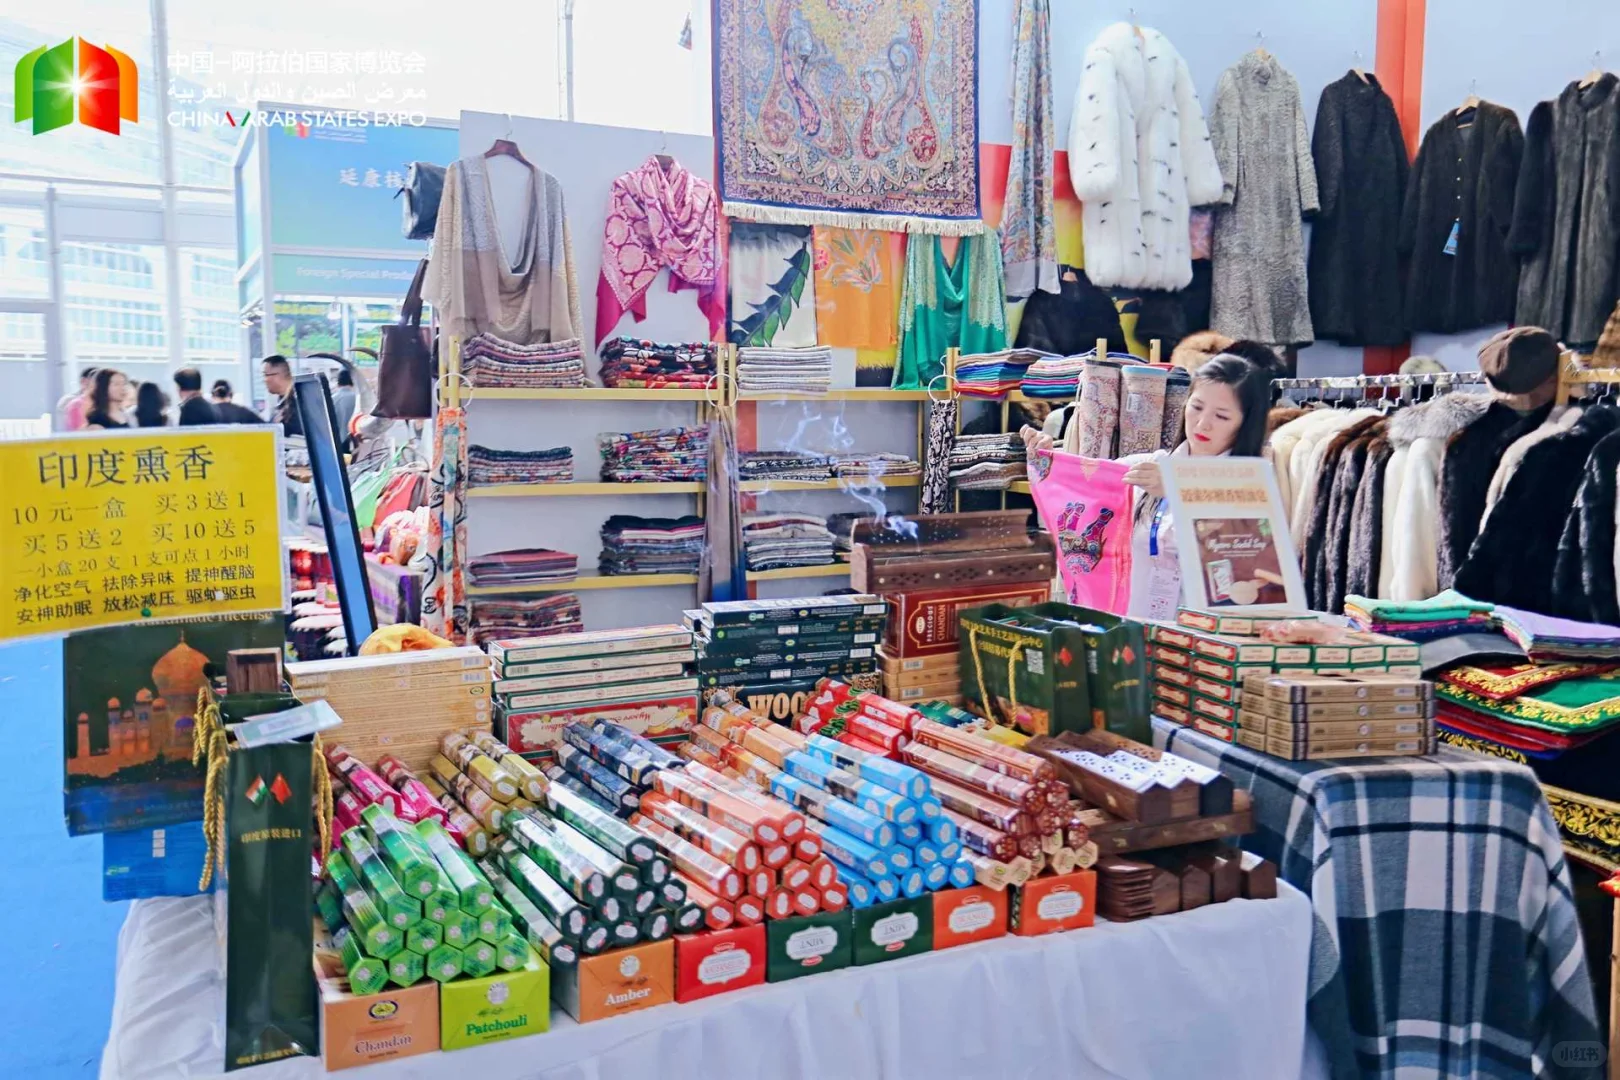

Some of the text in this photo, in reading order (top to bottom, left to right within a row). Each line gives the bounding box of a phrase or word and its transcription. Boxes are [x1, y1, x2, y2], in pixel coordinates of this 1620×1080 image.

[38, 445, 214, 489] 印度熏香
[14, 564, 255, 603] 净化空气 祛除异味 提神醒脑
[16, 600, 93, 625] 安神助眠
[103, 590, 175, 613] 放松减压
[926, 605, 934, 642] PRECIOUS
[936, 604, 946, 640] CHANDAN
[604, 987, 651, 1006] Amber
[466, 1015, 528, 1036] Patchouli
[355, 1035, 413, 1055] Chandan
